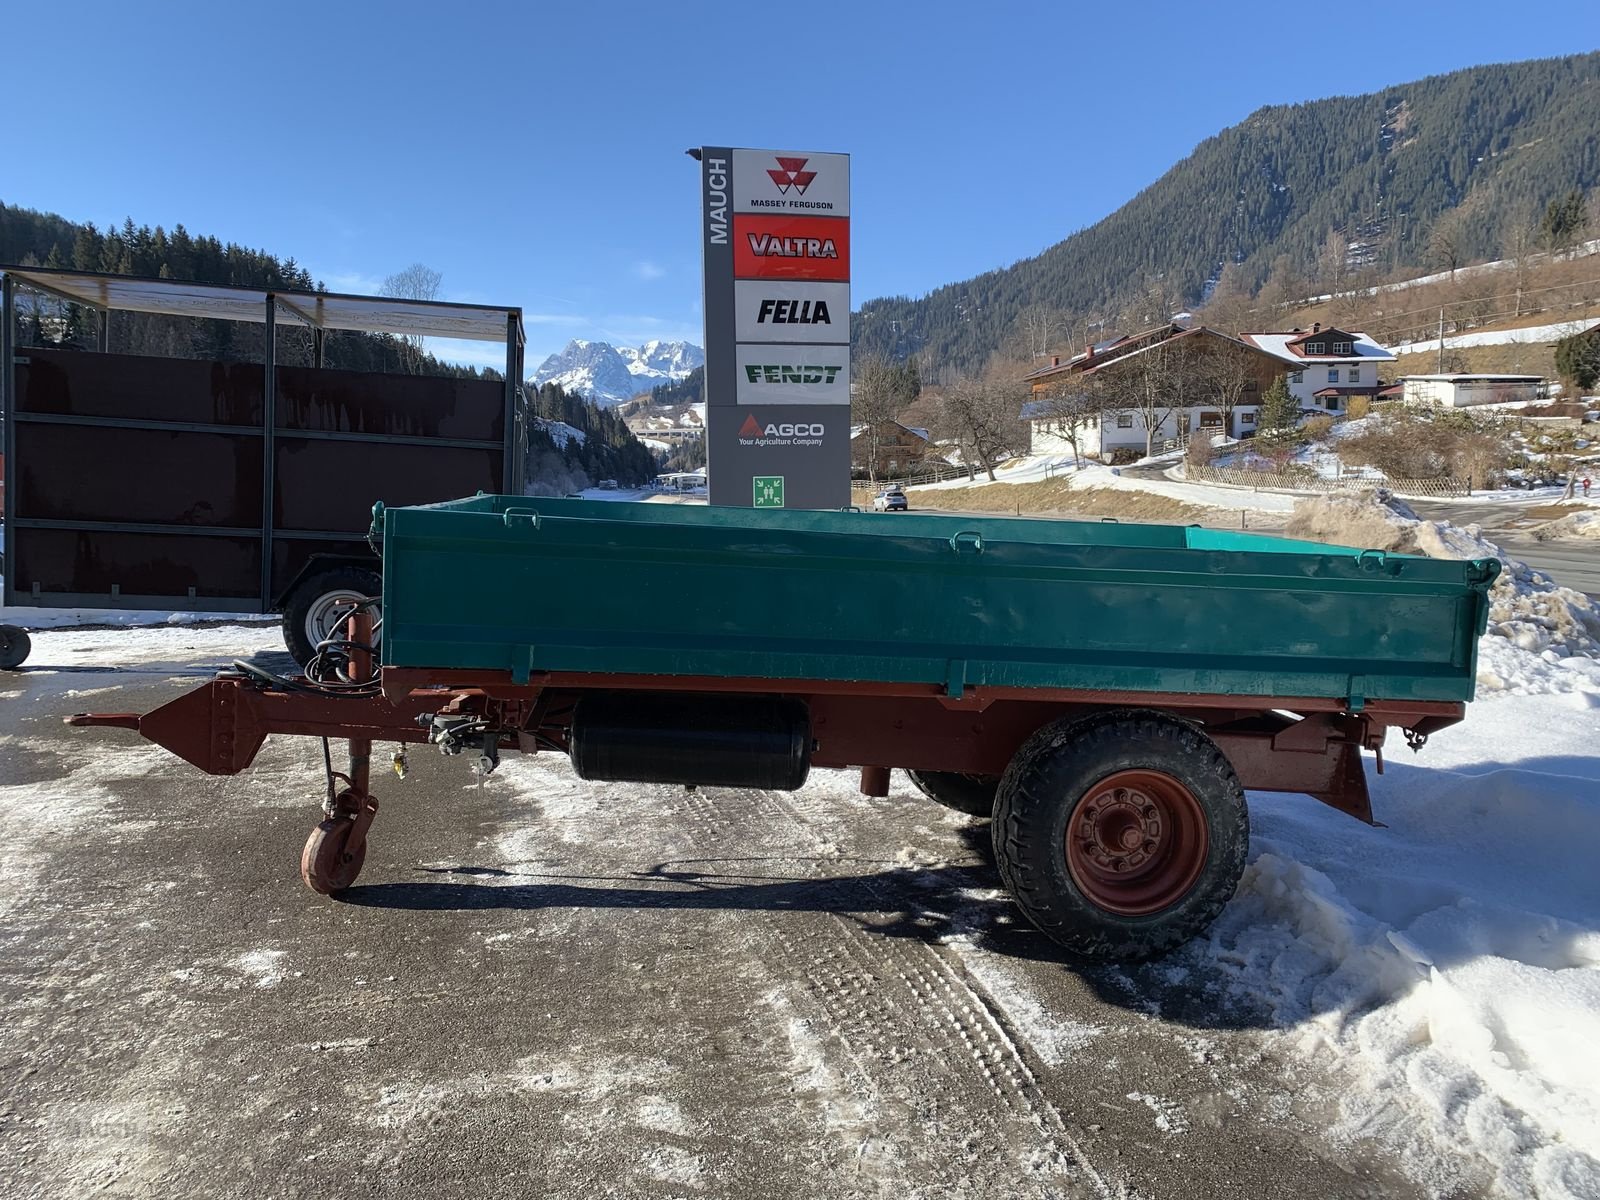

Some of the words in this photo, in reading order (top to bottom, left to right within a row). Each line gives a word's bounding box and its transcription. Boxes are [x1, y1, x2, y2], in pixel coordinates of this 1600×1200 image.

[709, 158, 728, 245] MAUCH
[750, 199, 786, 208] MASSEY
[789, 201, 833, 209] FERGUSON
[747, 233, 838, 259] VALTRA
[757, 299, 831, 324] FELLA
[744, 365, 842, 384] FENDT
[764, 423, 825, 437] AGCO
[739, 438, 754, 446] Your
[755, 438, 792, 447] Agriculture
[792, 438, 823, 447] Company
